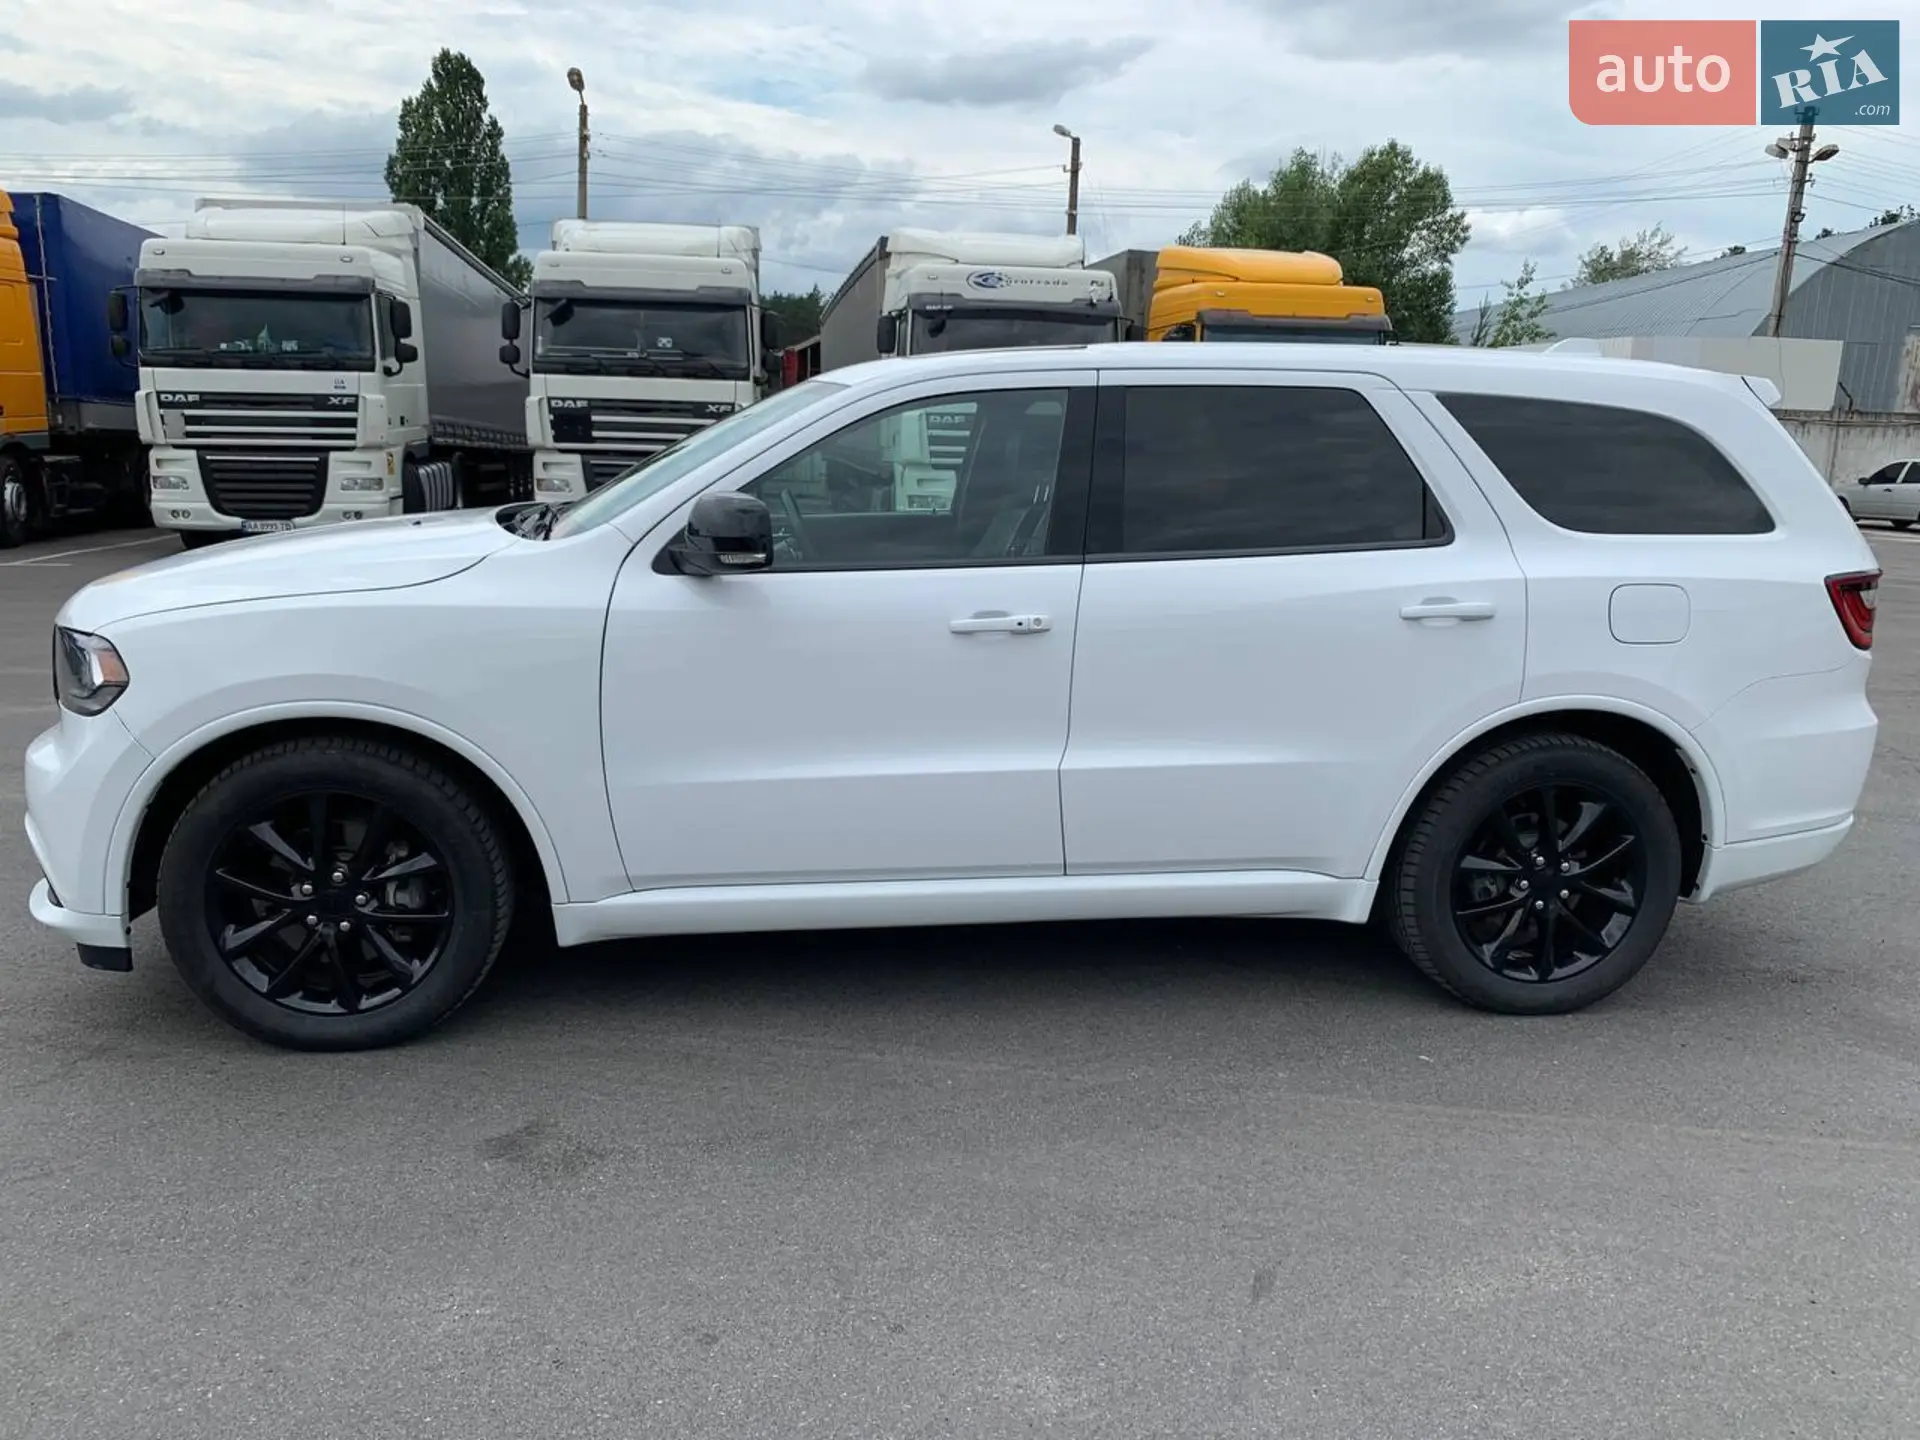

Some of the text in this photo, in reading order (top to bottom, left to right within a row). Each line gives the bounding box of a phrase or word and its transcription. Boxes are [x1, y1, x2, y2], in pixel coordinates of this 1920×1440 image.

[160, 394, 200, 402] DAF
[328, 396, 355, 405] XF
[551, 400, 588, 408] DAF
[706, 404, 733, 413] XF
[929, 415, 966, 424] DAF
